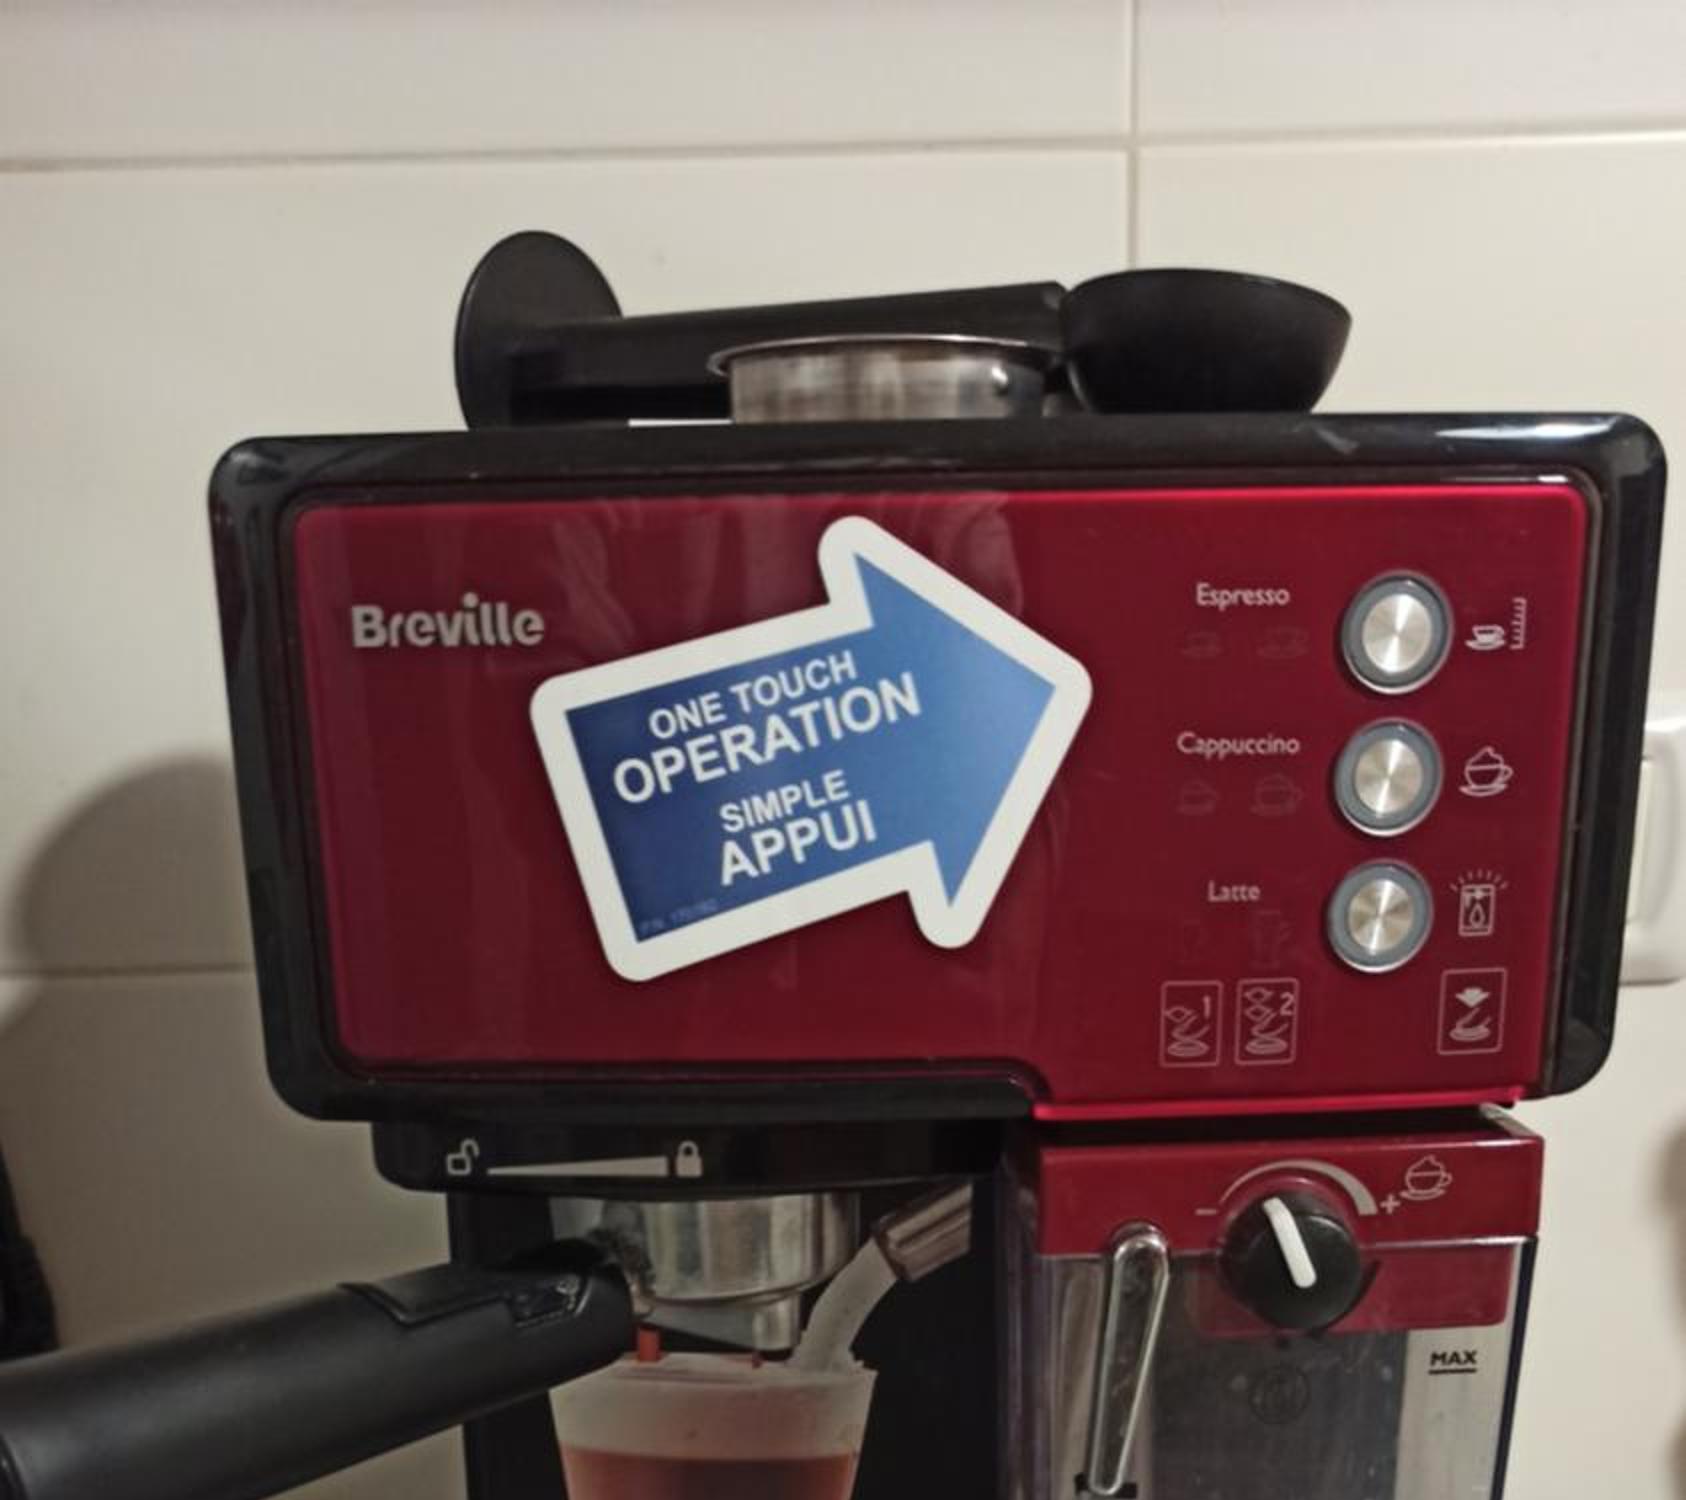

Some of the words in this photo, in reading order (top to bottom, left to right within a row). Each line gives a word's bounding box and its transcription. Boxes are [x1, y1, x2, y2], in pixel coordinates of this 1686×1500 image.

[1196, 582, 1290, 610] Espresso
[351, 592, 544, 647] Breville
[649, 692, 727, 738] ONE
[730, 650, 857, 713] TOUCH
[613, 671, 922, 803] OPERATION
[1176, 731, 1301, 759] Cappuccino
[720, 769, 850, 833] SIMPLE
[720, 800, 877, 887] APPUI
[1207, 881, 1261, 902] Latte
[1203, 996, 1211, 1018] 1
[1279, 993, 1295, 1017] 2
[1430, 1350, 1478, 1368] MAX
